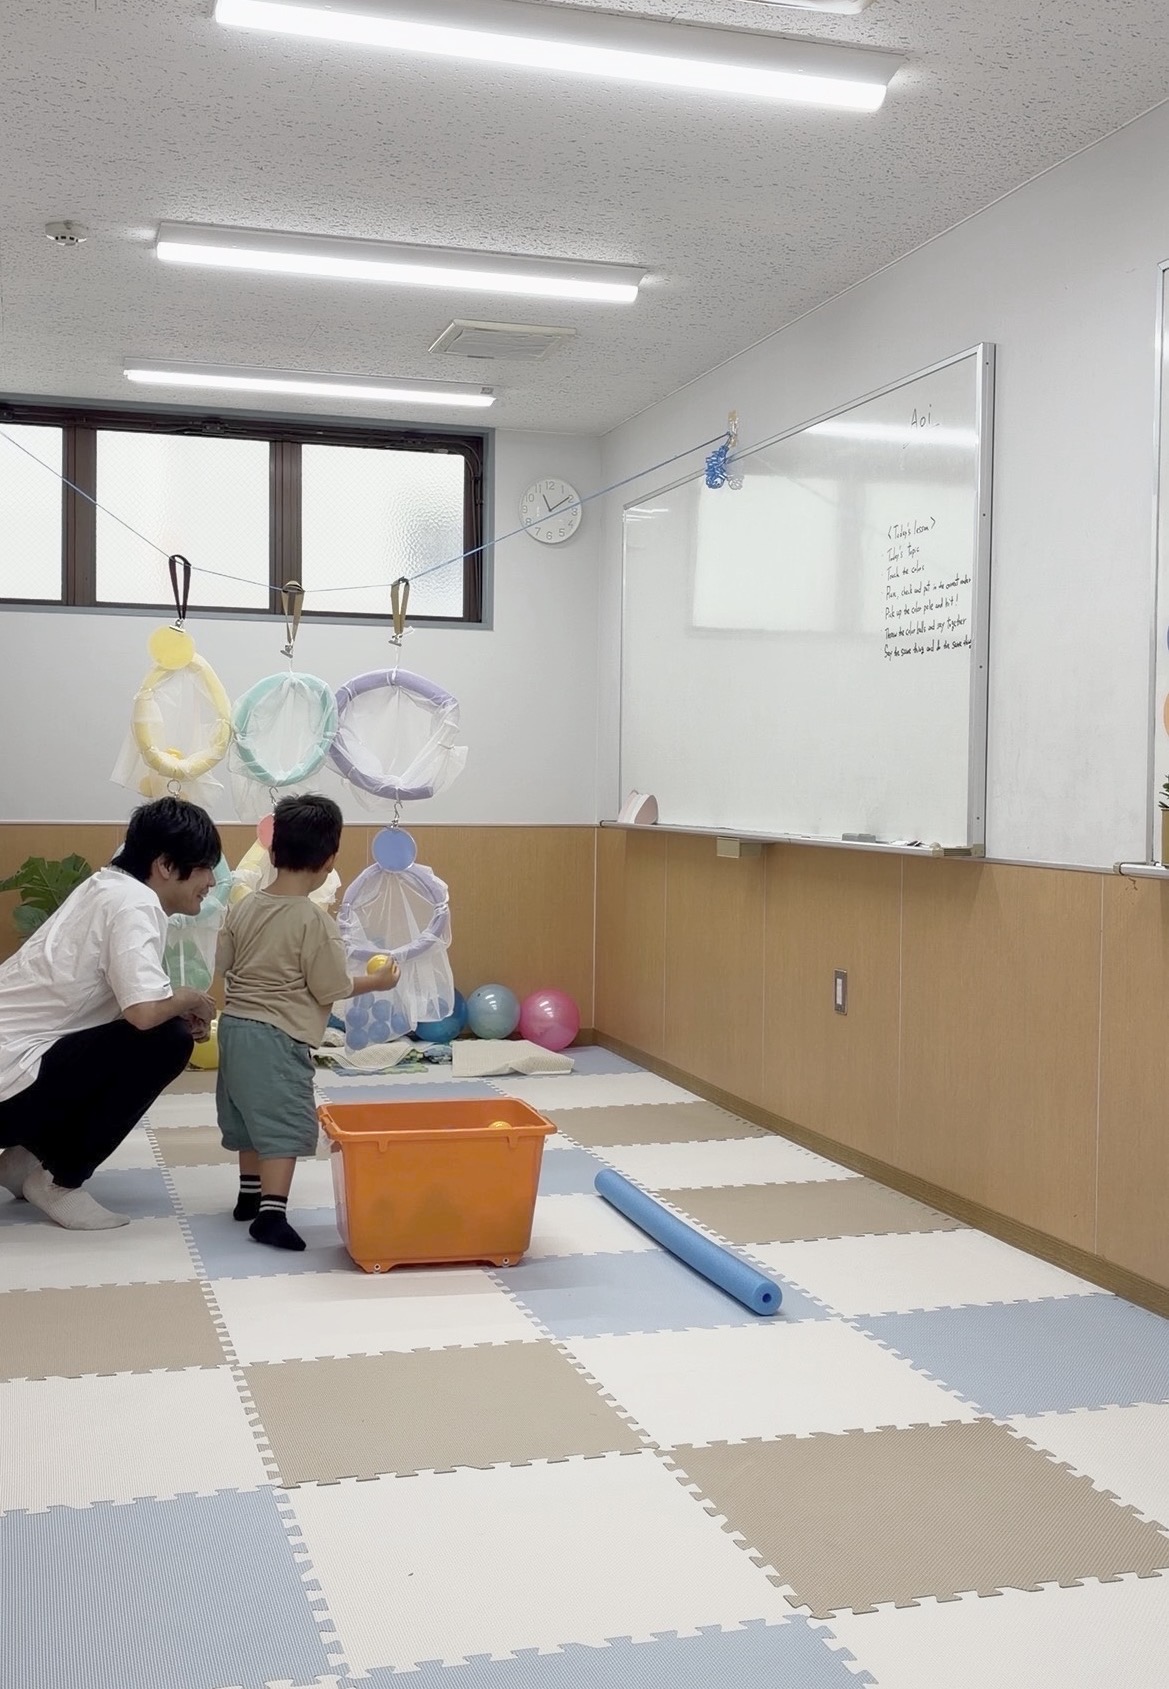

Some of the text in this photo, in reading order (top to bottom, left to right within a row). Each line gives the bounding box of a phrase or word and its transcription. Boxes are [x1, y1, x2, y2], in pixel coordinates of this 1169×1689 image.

[534, 484, 542, 493] 11
[545, 481, 555, 490] 12
[525, 493, 535, 503] 10
[567, 494, 574, 503] 2
[522, 505, 528, 514] 9
[571, 508, 578, 517] 3
[567, 520, 574, 529] 4
[534, 526, 541, 536] 7
[546, 531, 553, 540] 6
[558, 528, 565, 537] 5
[914, 581, 922, 593] and
[885, 605, 895, 620] Pick
[911, 601, 922, 614] color
[935, 597, 943, 609] and
[927, 619, 935, 631] and
[946, 613, 967, 632] together
[884, 644, 893, 661] Say
[926, 639, 935, 652] and
